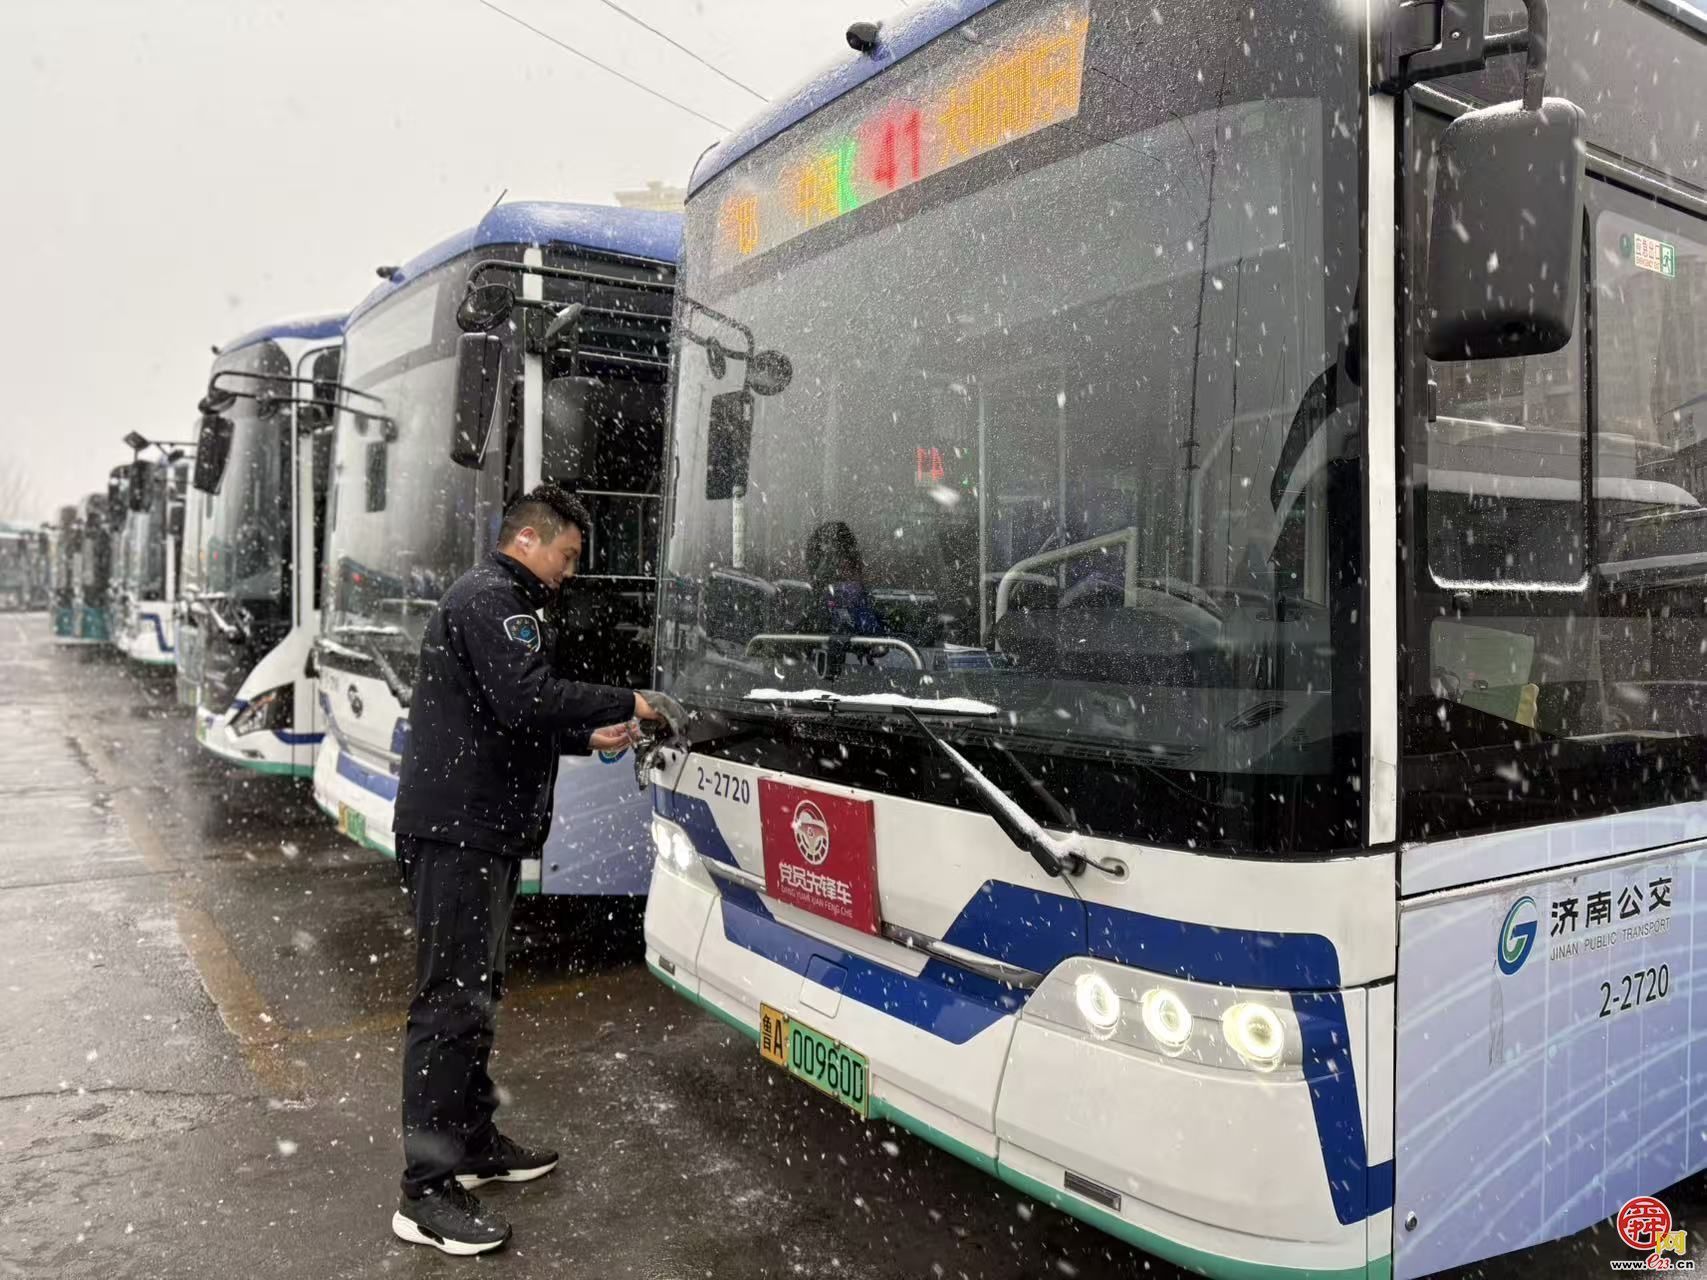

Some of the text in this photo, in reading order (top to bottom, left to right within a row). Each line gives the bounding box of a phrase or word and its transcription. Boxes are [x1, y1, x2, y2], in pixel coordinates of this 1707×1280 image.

[697, 766, 750, 805] 2-2720
[778, 861, 853, 905] 党员先锋车
[1550, 877, 1672, 937] 济南公交
[1550, 917, 1671, 961] JINAN PUBLIC TRANSPORT
[1599, 963, 1669, 1018] 2-2720
